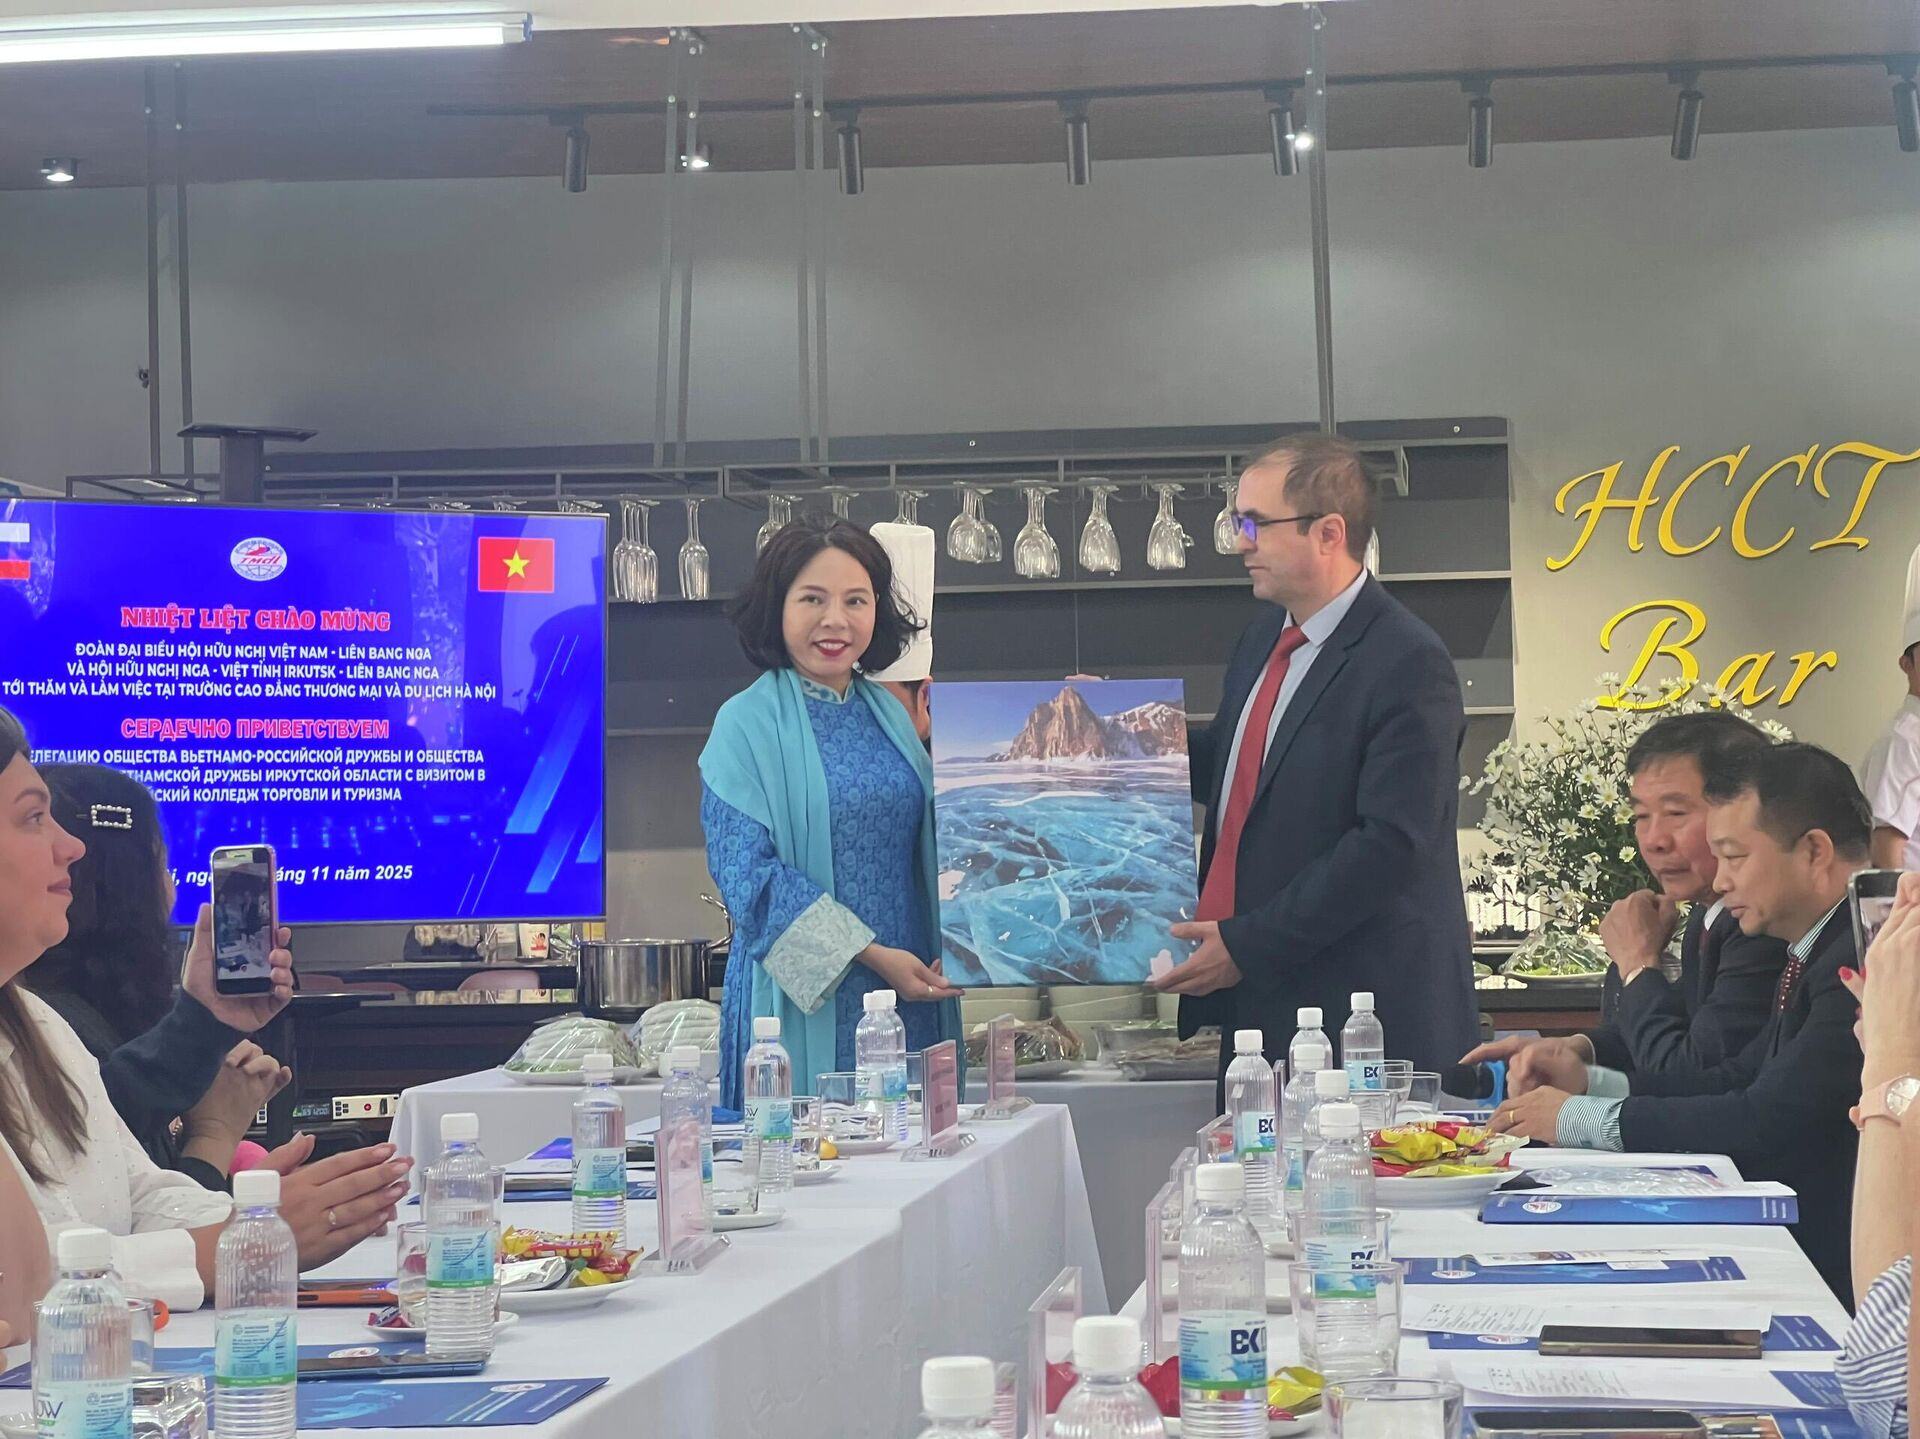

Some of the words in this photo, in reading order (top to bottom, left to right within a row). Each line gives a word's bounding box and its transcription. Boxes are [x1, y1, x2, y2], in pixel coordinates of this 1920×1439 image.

[1546, 441, 1920, 571] HCCT
[121, 602, 195, 634] NHIỆT
[200, 603, 250, 634] LIỆT
[255, 606, 316, 630] CHÀO
[320, 607, 391, 631] MỪNG
[75, 640, 114, 657] ĐOÀN
[118, 643, 141, 659] ĐẠI
[145, 639, 174, 657] BIỂU
[178, 641, 200, 660] HỘI
[204, 641, 231, 658] HỮU
[235, 645, 266, 661] NGHỊ
[269, 643, 297, 661] VIỆT
[300, 647, 328, 659] NAM
[339, 644, 365, 659] LIÊN
[369, 647, 403, 660] BANG
[406, 648, 432, 660] NGA
[1594, 599, 1838, 710] Bar
[67, 660, 85, 676] VÀ
[89, 661, 112, 679] HỘI
[115, 661, 144, 676] HỮU
[147, 663, 179, 680] NGHỊ
[183, 663, 210, 677] NGA
[220, 662, 249, 681] VIỆT
[251, 660, 281, 678] TỈNH
[284, 665, 336, 679] IRKUTSK
[346, 662, 373, 679] LIÊN
[377, 666, 411, 680] BANG
[414, 667, 439, 680] NGA
[2, 679, 24, 695] TỚI
[28, 679, 66, 695] THĂM
[69, 679, 88, 695] VÀ
[91, 679, 119, 696] LÀM
[122, 681, 152, 700] VIỆC
[155, 683, 175, 700] TẠI
[178, 680, 232, 697] TRƯỜNG
[235, 684, 262, 697] CAO
[265, 678, 301, 697] ĐẲNG
[304, 683, 356, 698] THƯƠNG
[359, 685, 382, 701] MẠI
[385, 682, 401, 698] VÀ
[405, 686, 423, 698] DU
[425, 686, 451, 702] LỊCH
[454, 683, 472, 698] HÀ
[475, 683, 496, 702] NỘI
[121, 718, 231, 742] СЕРДЕЧНО
[236, 719, 390, 739] ПРИВЕТСТВУЕМ
[103, 749, 178, 765] ОБЩЕСТВА
[181, 747, 342, 763] ВЬЕТНАМО-РОССИЙСКОЙ
[345, 749, 401, 765] ДРУЖБЫ
[405, 750, 413, 763] И
[416, 749, 484, 765] ОБЩЕСТВА
[120, 766, 200, 782] ТНАМСКОЙ
[203, 769, 262, 784] ДРУЖБЫ
[266, 766, 339, 782] ИРКУТСКОЙ
[343, 769, 402, 782] ОБЛАСТИ
[405, 769, 413, 781] С
[416, 769, 474, 781] ВИЗИТОМ
[477, 769, 486, 781] В
[193, 788, 259, 803] КОЛЛЕДЖ
[262, 788, 328, 801] ТОРГОВЛИ
[332, 788, 340, 801] И
[344, 788, 402, 801] ТУРИЗМА
[312, 866, 330, 881] 11
[334, 867, 370, 881] năm
[375, 865, 413, 880] 2025
